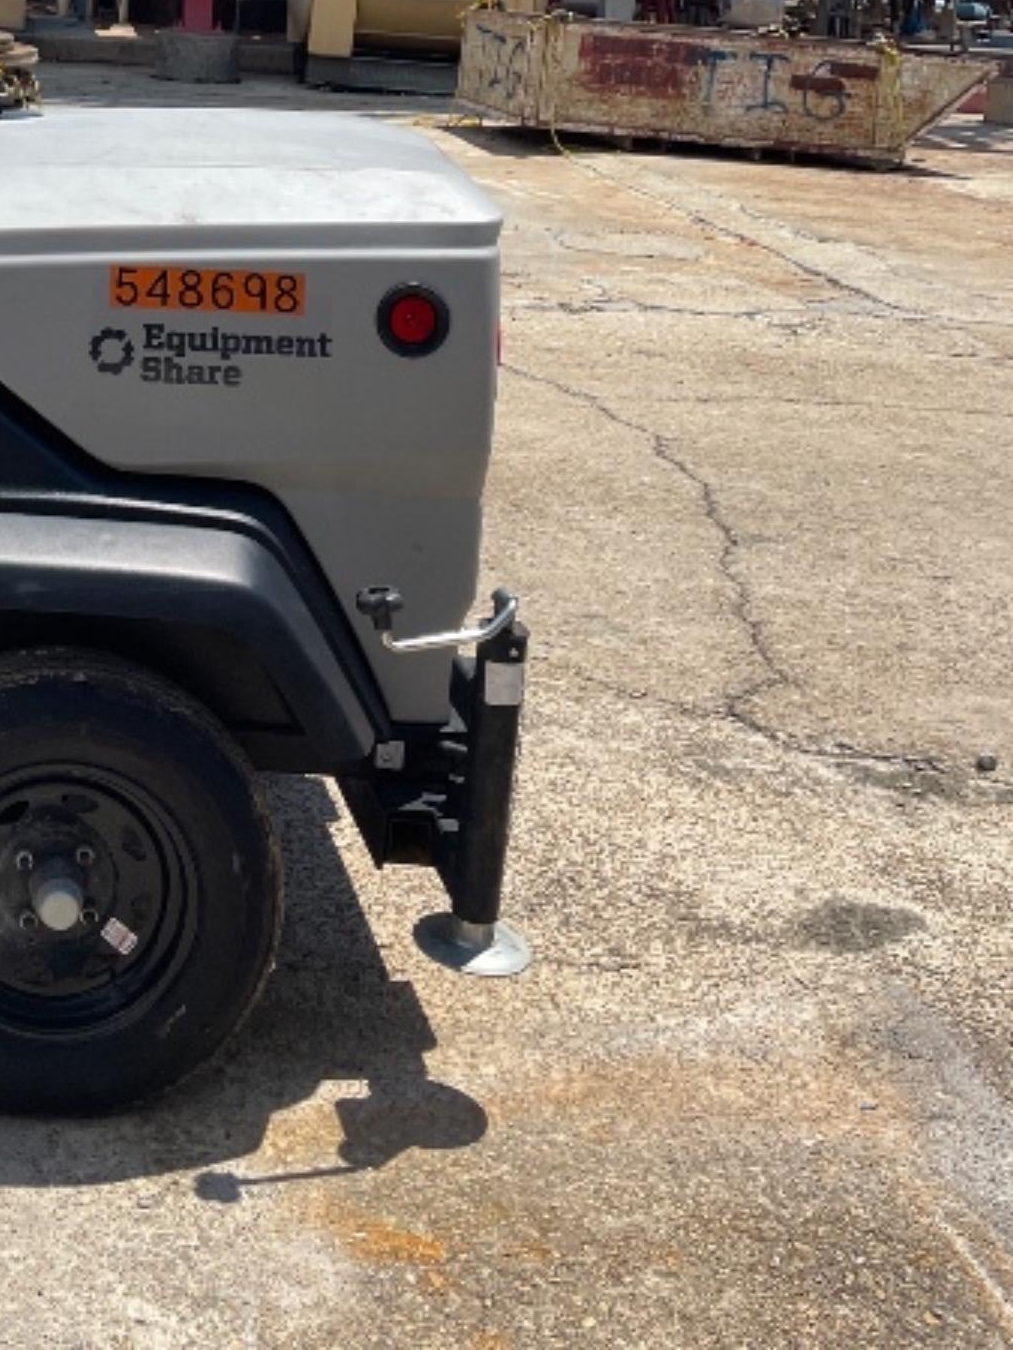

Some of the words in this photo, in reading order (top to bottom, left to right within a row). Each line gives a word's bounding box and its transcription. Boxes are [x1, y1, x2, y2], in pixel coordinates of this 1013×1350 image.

[114, 265, 300, 314] 548698
[142, 322, 333, 361] Equipment
[140, 355, 243, 387] Share
